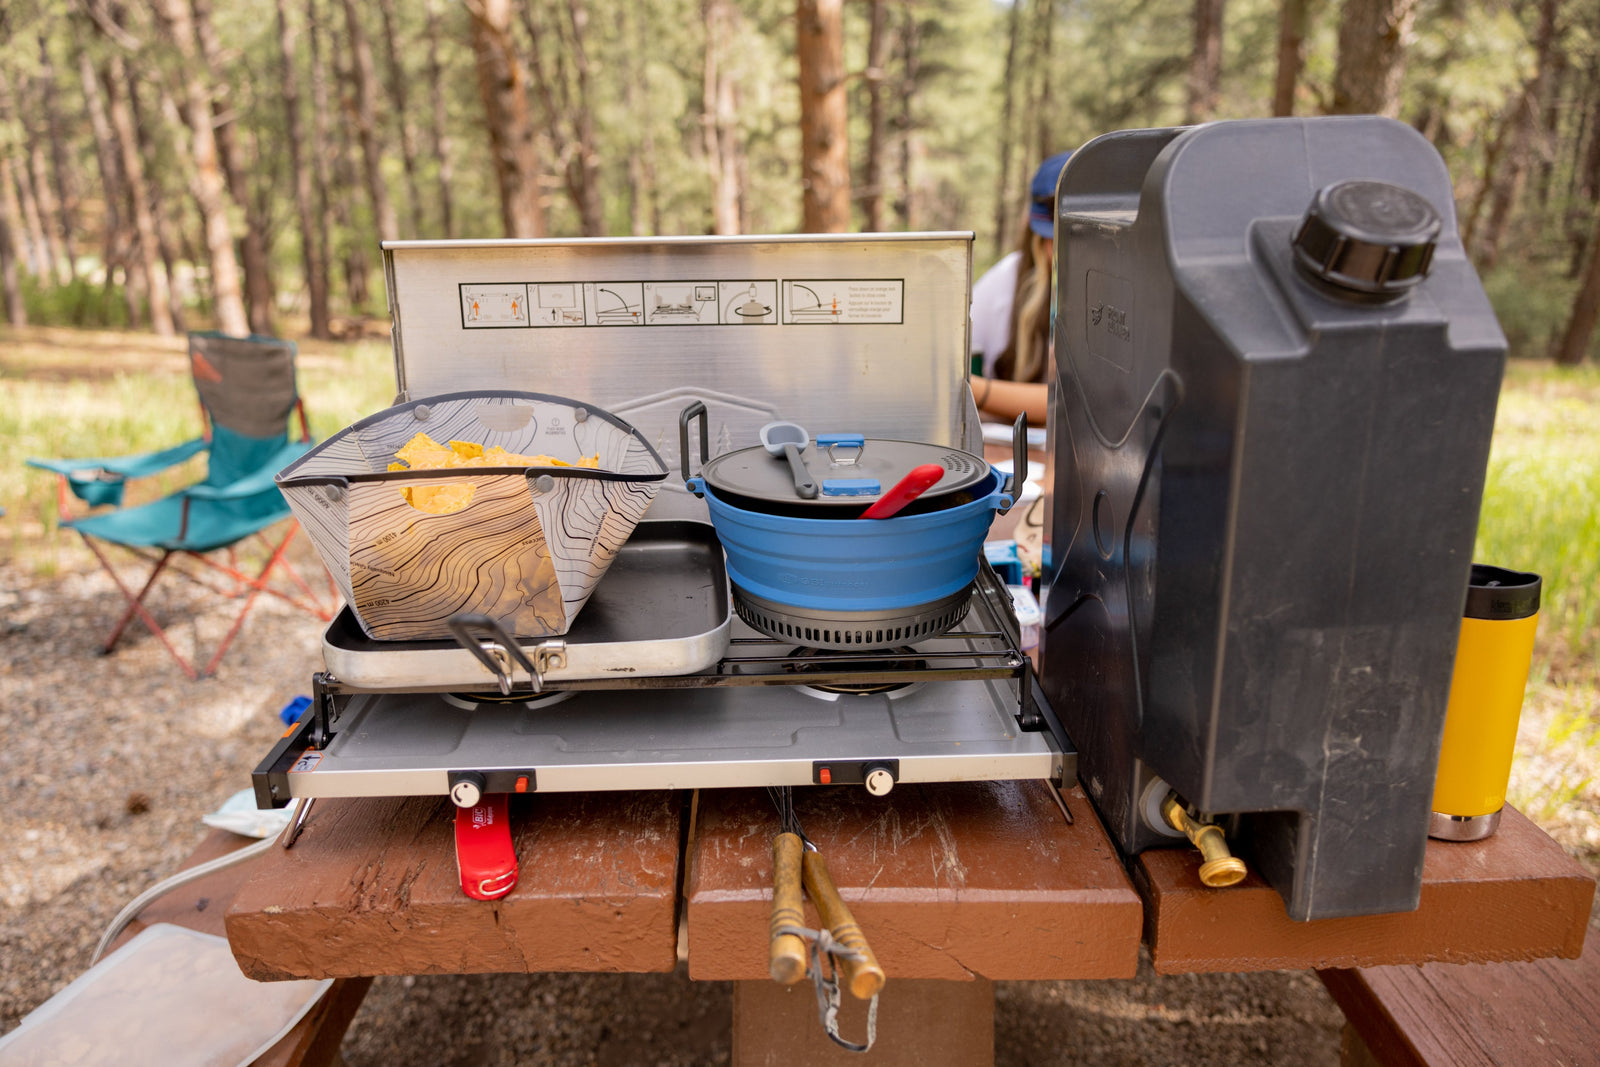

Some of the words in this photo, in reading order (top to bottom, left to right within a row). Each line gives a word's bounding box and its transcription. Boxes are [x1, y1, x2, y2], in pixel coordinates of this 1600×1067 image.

[595, 511, 608, 536] Tahoma
[382, 531, 398, 543] 4100
[374, 599, 390, 608] 4200
